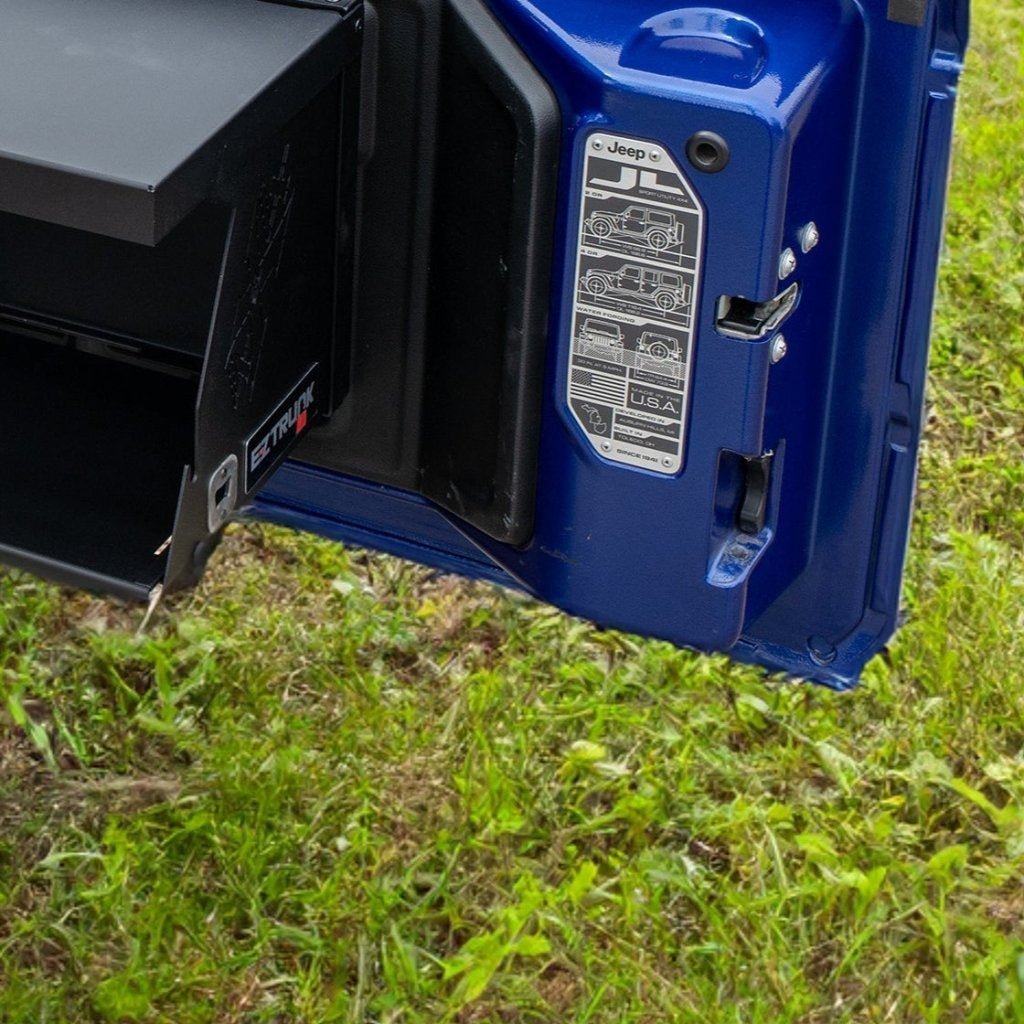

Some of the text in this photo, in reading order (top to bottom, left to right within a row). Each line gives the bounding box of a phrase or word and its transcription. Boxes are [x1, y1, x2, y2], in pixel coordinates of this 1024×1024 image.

[607, 142, 646, 160] Jeep
[589, 166, 685, 196] JL
[576, 306, 636, 323] WATER FORDING
[631, 387, 654, 396] MADE
[631, 392, 679, 414] U.S.A.
[616, 408, 657, 422] DEVELOPED
[617, 448, 642, 459] SINCE
